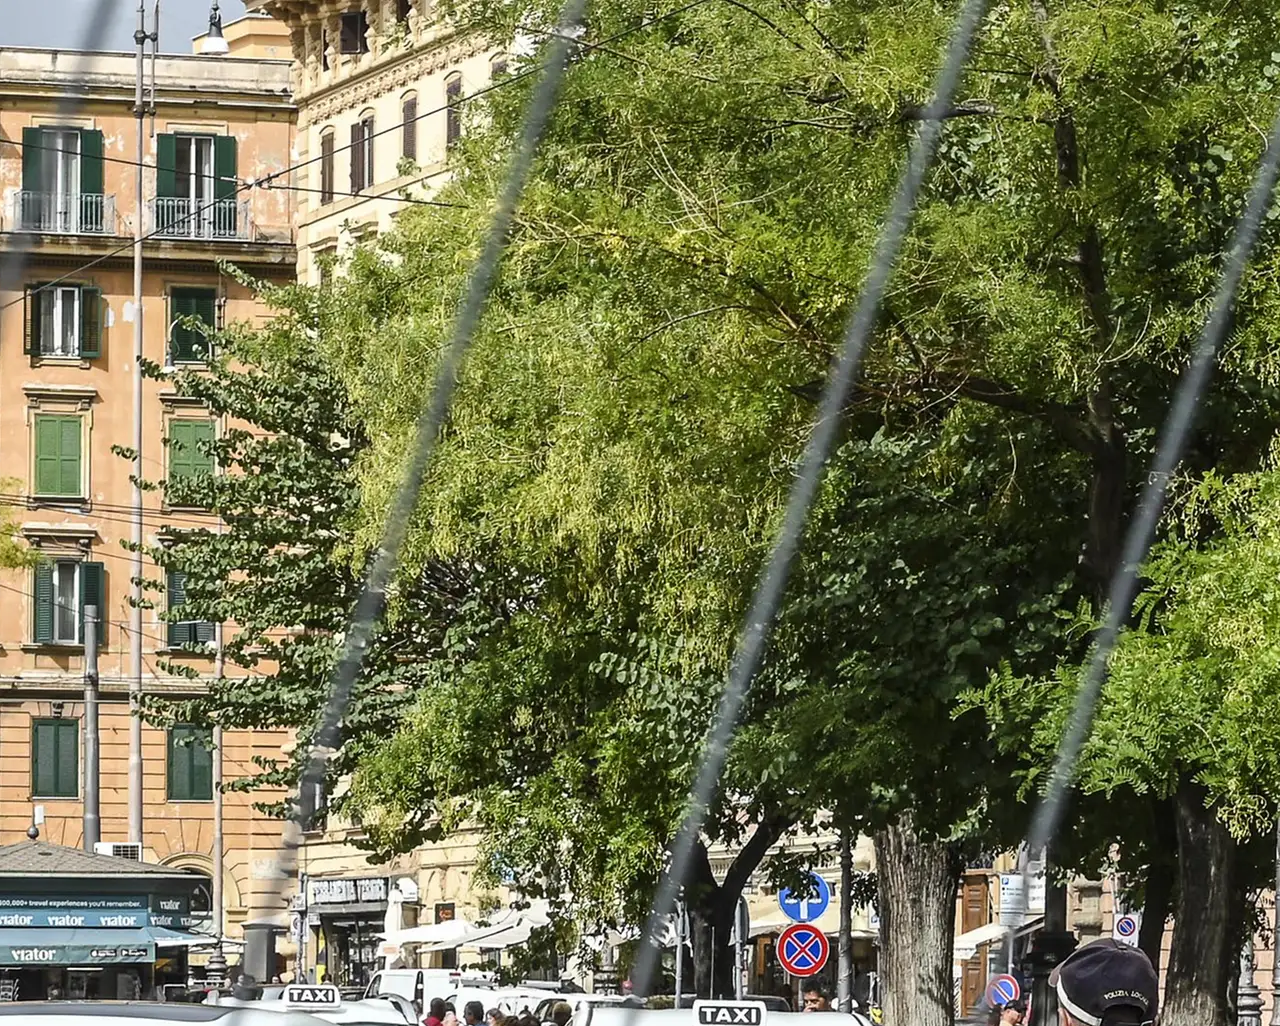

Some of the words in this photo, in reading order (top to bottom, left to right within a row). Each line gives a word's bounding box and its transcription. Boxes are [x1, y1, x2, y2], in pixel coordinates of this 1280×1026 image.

[49, 900, 88, 908] experiences
[88, 900, 105, 908] you'll
[106, 900, 142, 908] remember.
[160, 900, 180, 910] viator
[47, 914, 85, 926] viator
[100, 914, 137, 926] viator
[150, 915, 172, 926] viator
[11, 948, 57, 961] viator
[289, 989, 333, 1002] TAXI
[1104, 989, 1129, 1000] POLIZIA
[700, 1007, 757, 1023] TAXI
